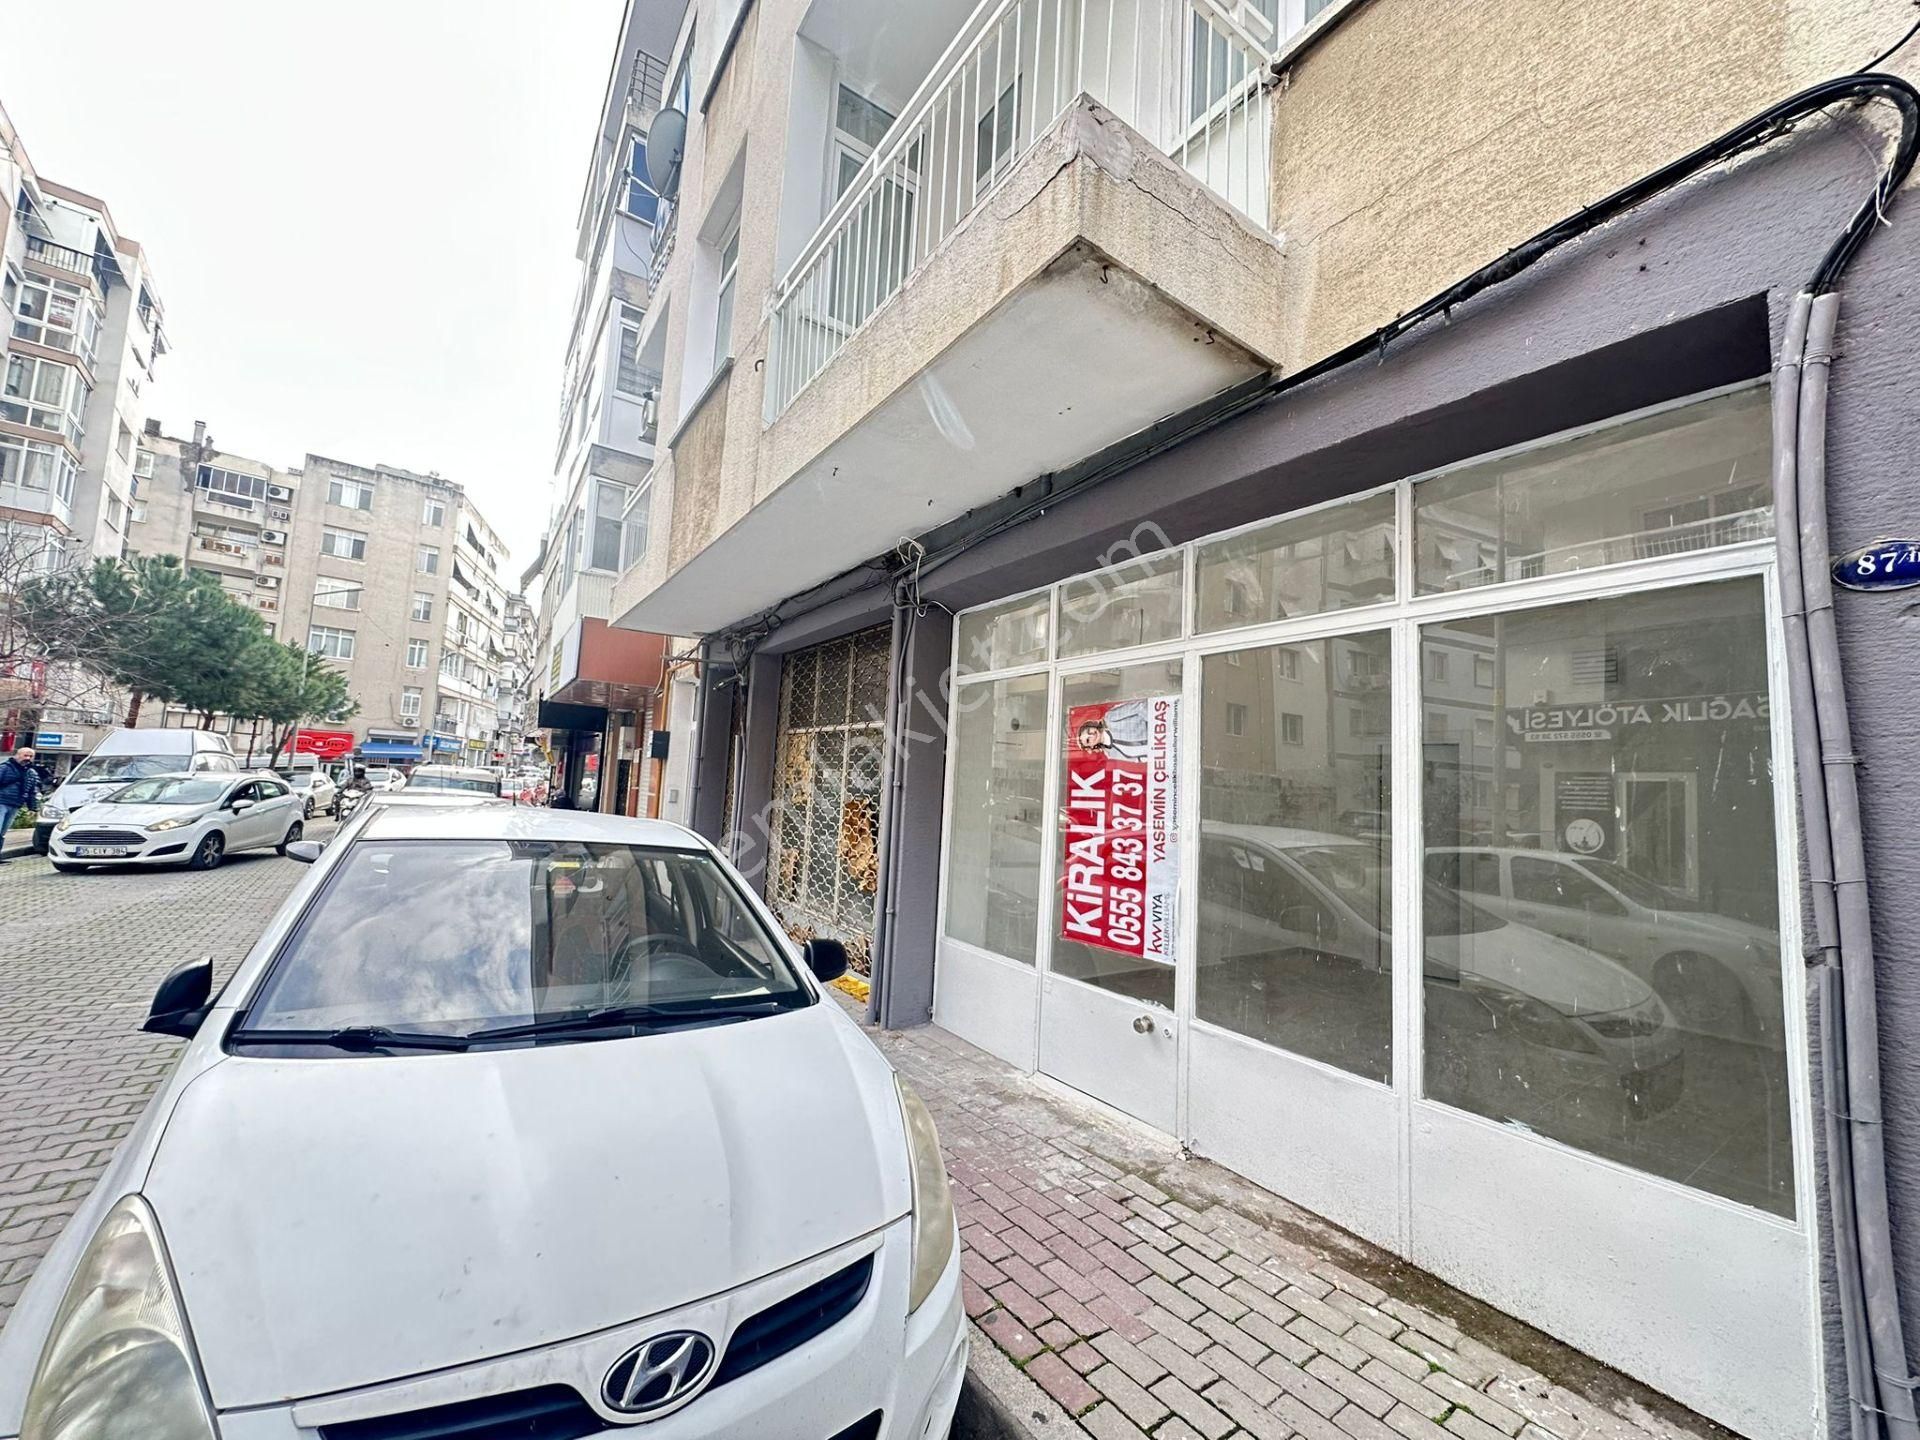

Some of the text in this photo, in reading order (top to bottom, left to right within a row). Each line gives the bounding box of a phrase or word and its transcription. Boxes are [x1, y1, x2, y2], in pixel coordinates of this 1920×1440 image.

[1108, 768, 1144, 946] 0555 843 37 37
[1150, 700, 1170, 863] YASEMİN ÇELİKBAŞ
[1151, 893, 1163, 922] VIYA
